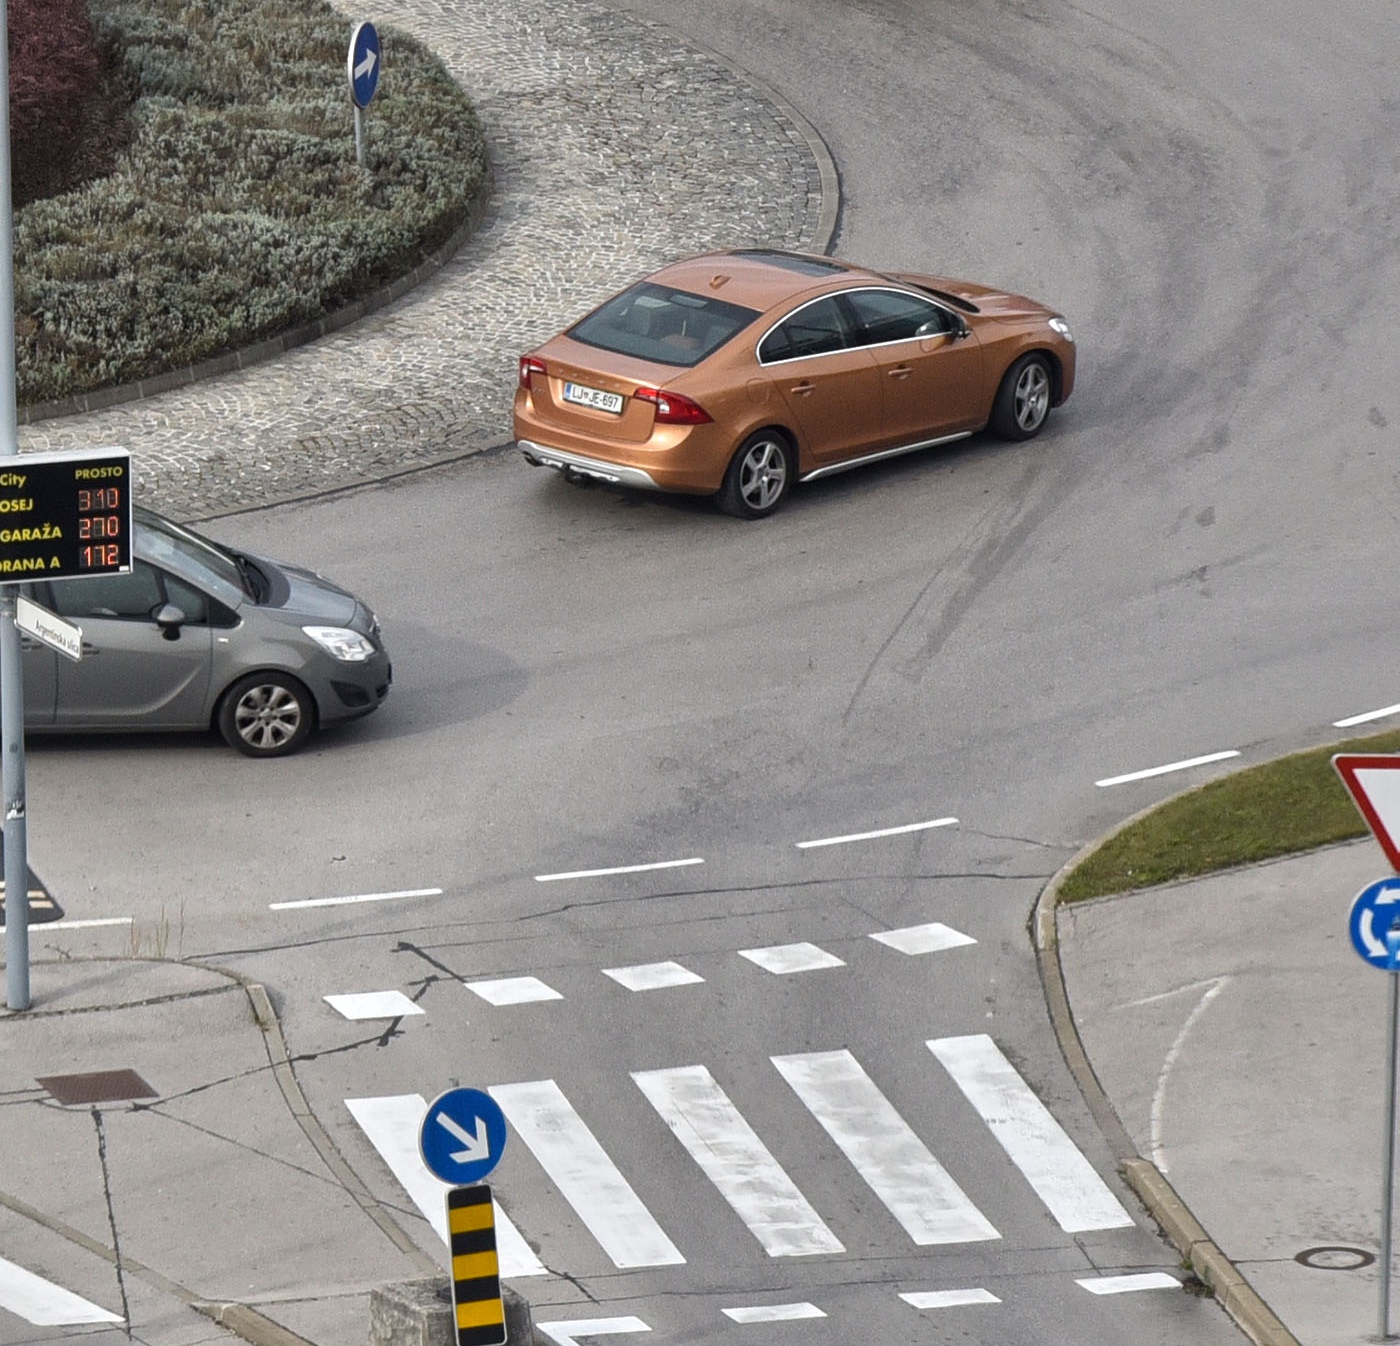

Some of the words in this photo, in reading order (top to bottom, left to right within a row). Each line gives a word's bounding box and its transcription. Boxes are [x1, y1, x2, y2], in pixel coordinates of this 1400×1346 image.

[589, 392, 619, 408] JE-697
[0, 472, 27, 489] City
[75, 466, 124, 480] PROSTO
[78, 487, 120, 512] 310
[0, 522, 63, 543] GARAŽA
[78, 516, 120, 540] 270
[50, 556, 61, 569] A
[83, 543, 120, 568] 172
